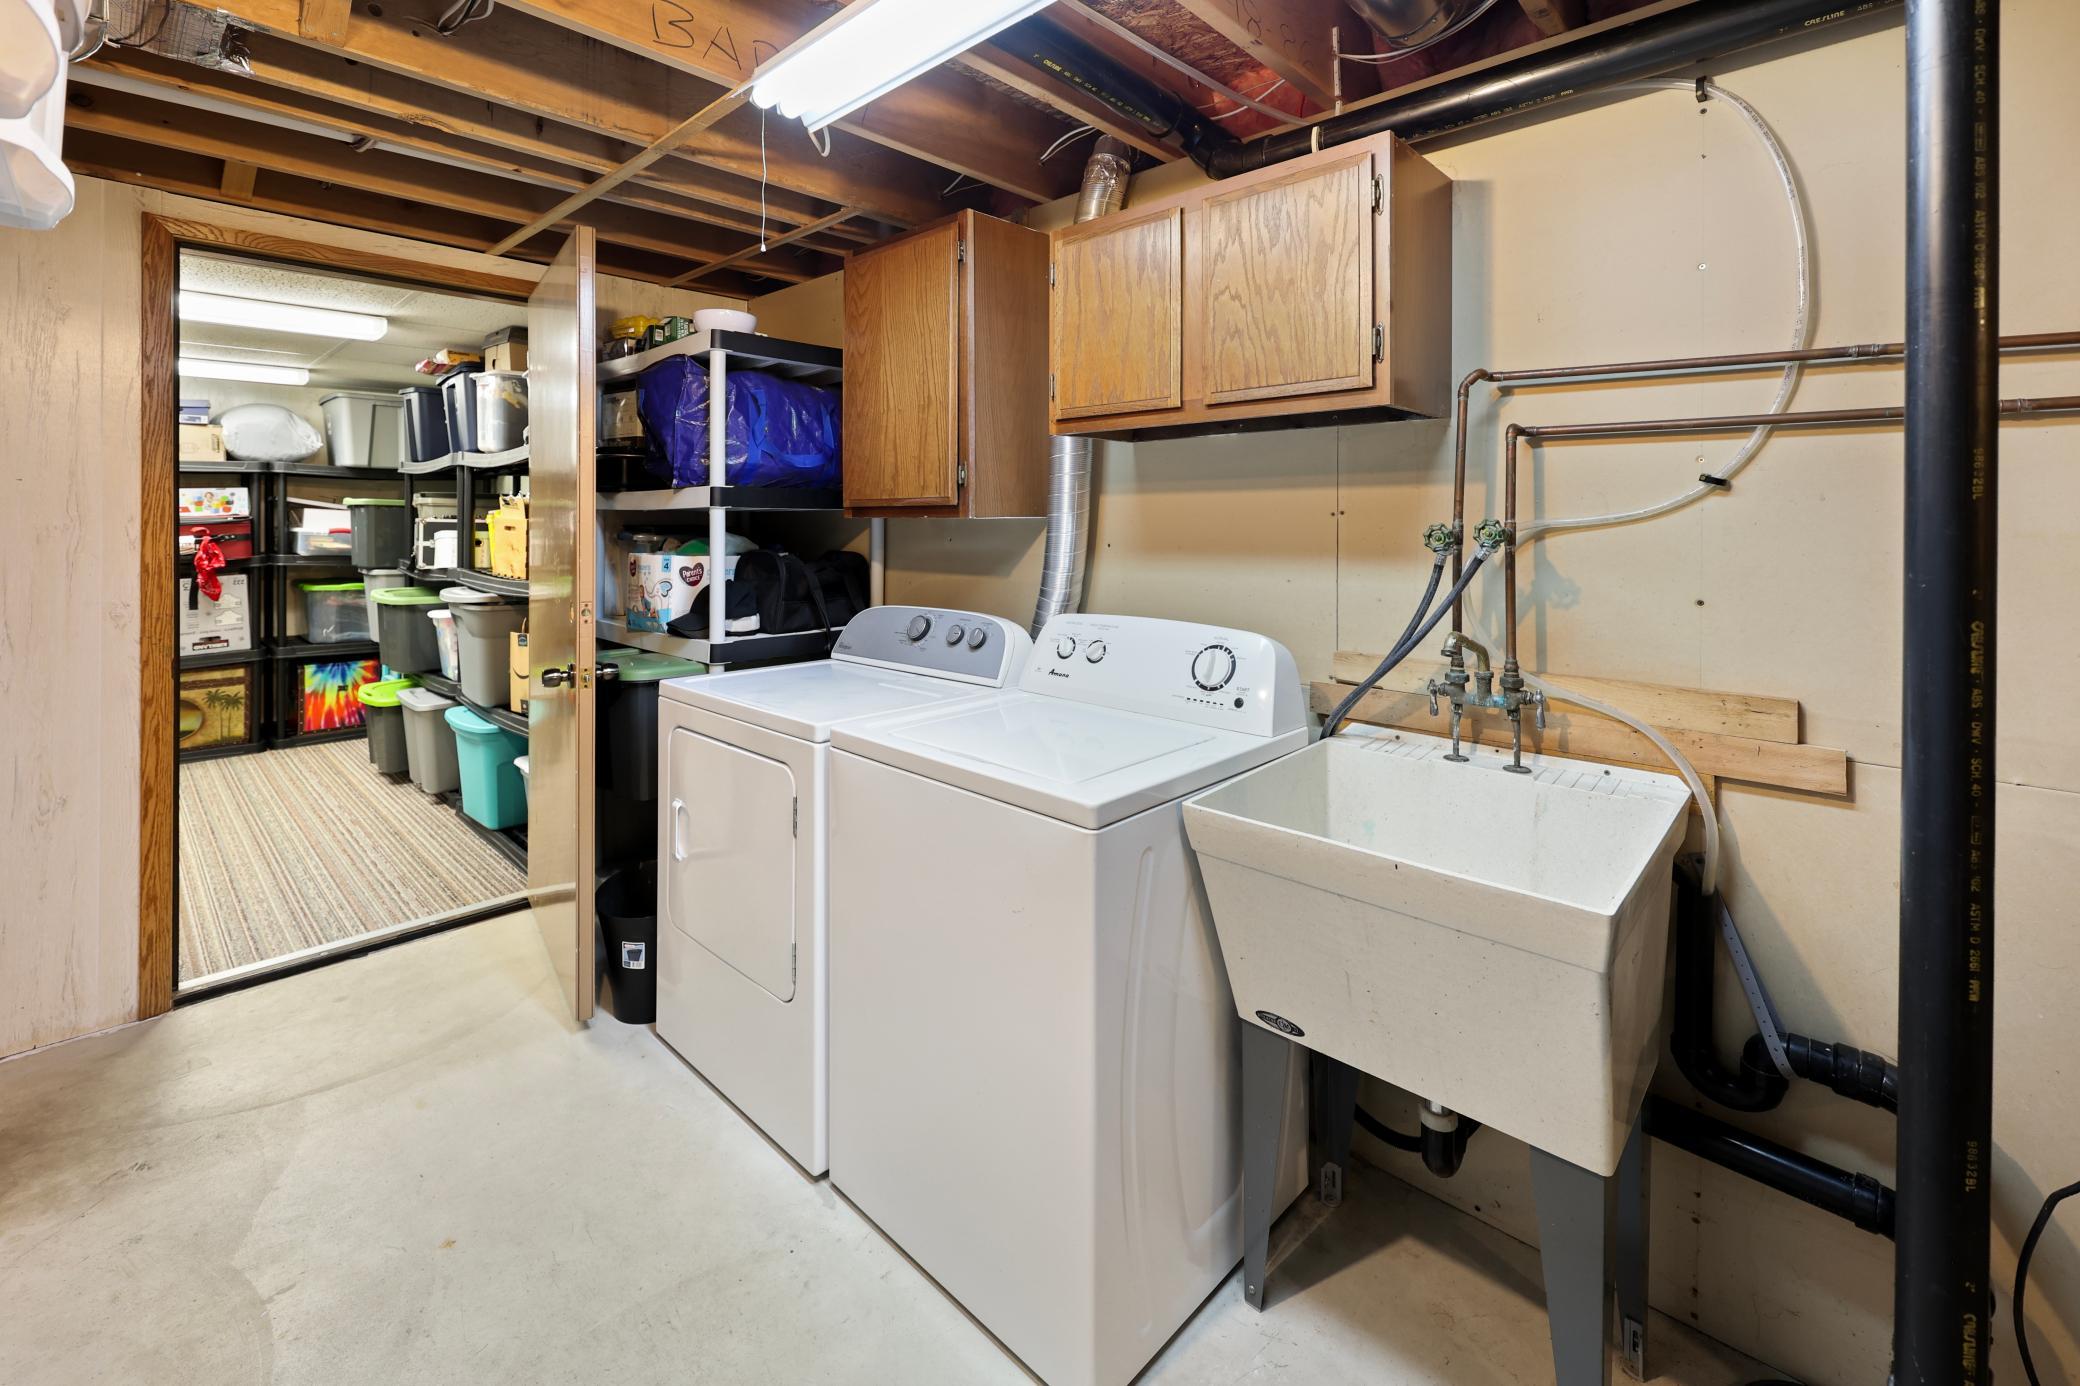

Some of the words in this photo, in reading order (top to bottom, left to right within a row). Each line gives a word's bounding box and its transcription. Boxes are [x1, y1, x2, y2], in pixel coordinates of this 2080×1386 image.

[1974, 156, 1986, 177] ABS
[1974, 210, 1986, 239] ASTM
[663, 562, 669, 570] 4
[1970, 688, 1983, 709] ABS
[1970, 721, 1983, 745] DWV
[1970, 783, 1983, 797] 40
[1969, 903, 1981, 932] ASTM
